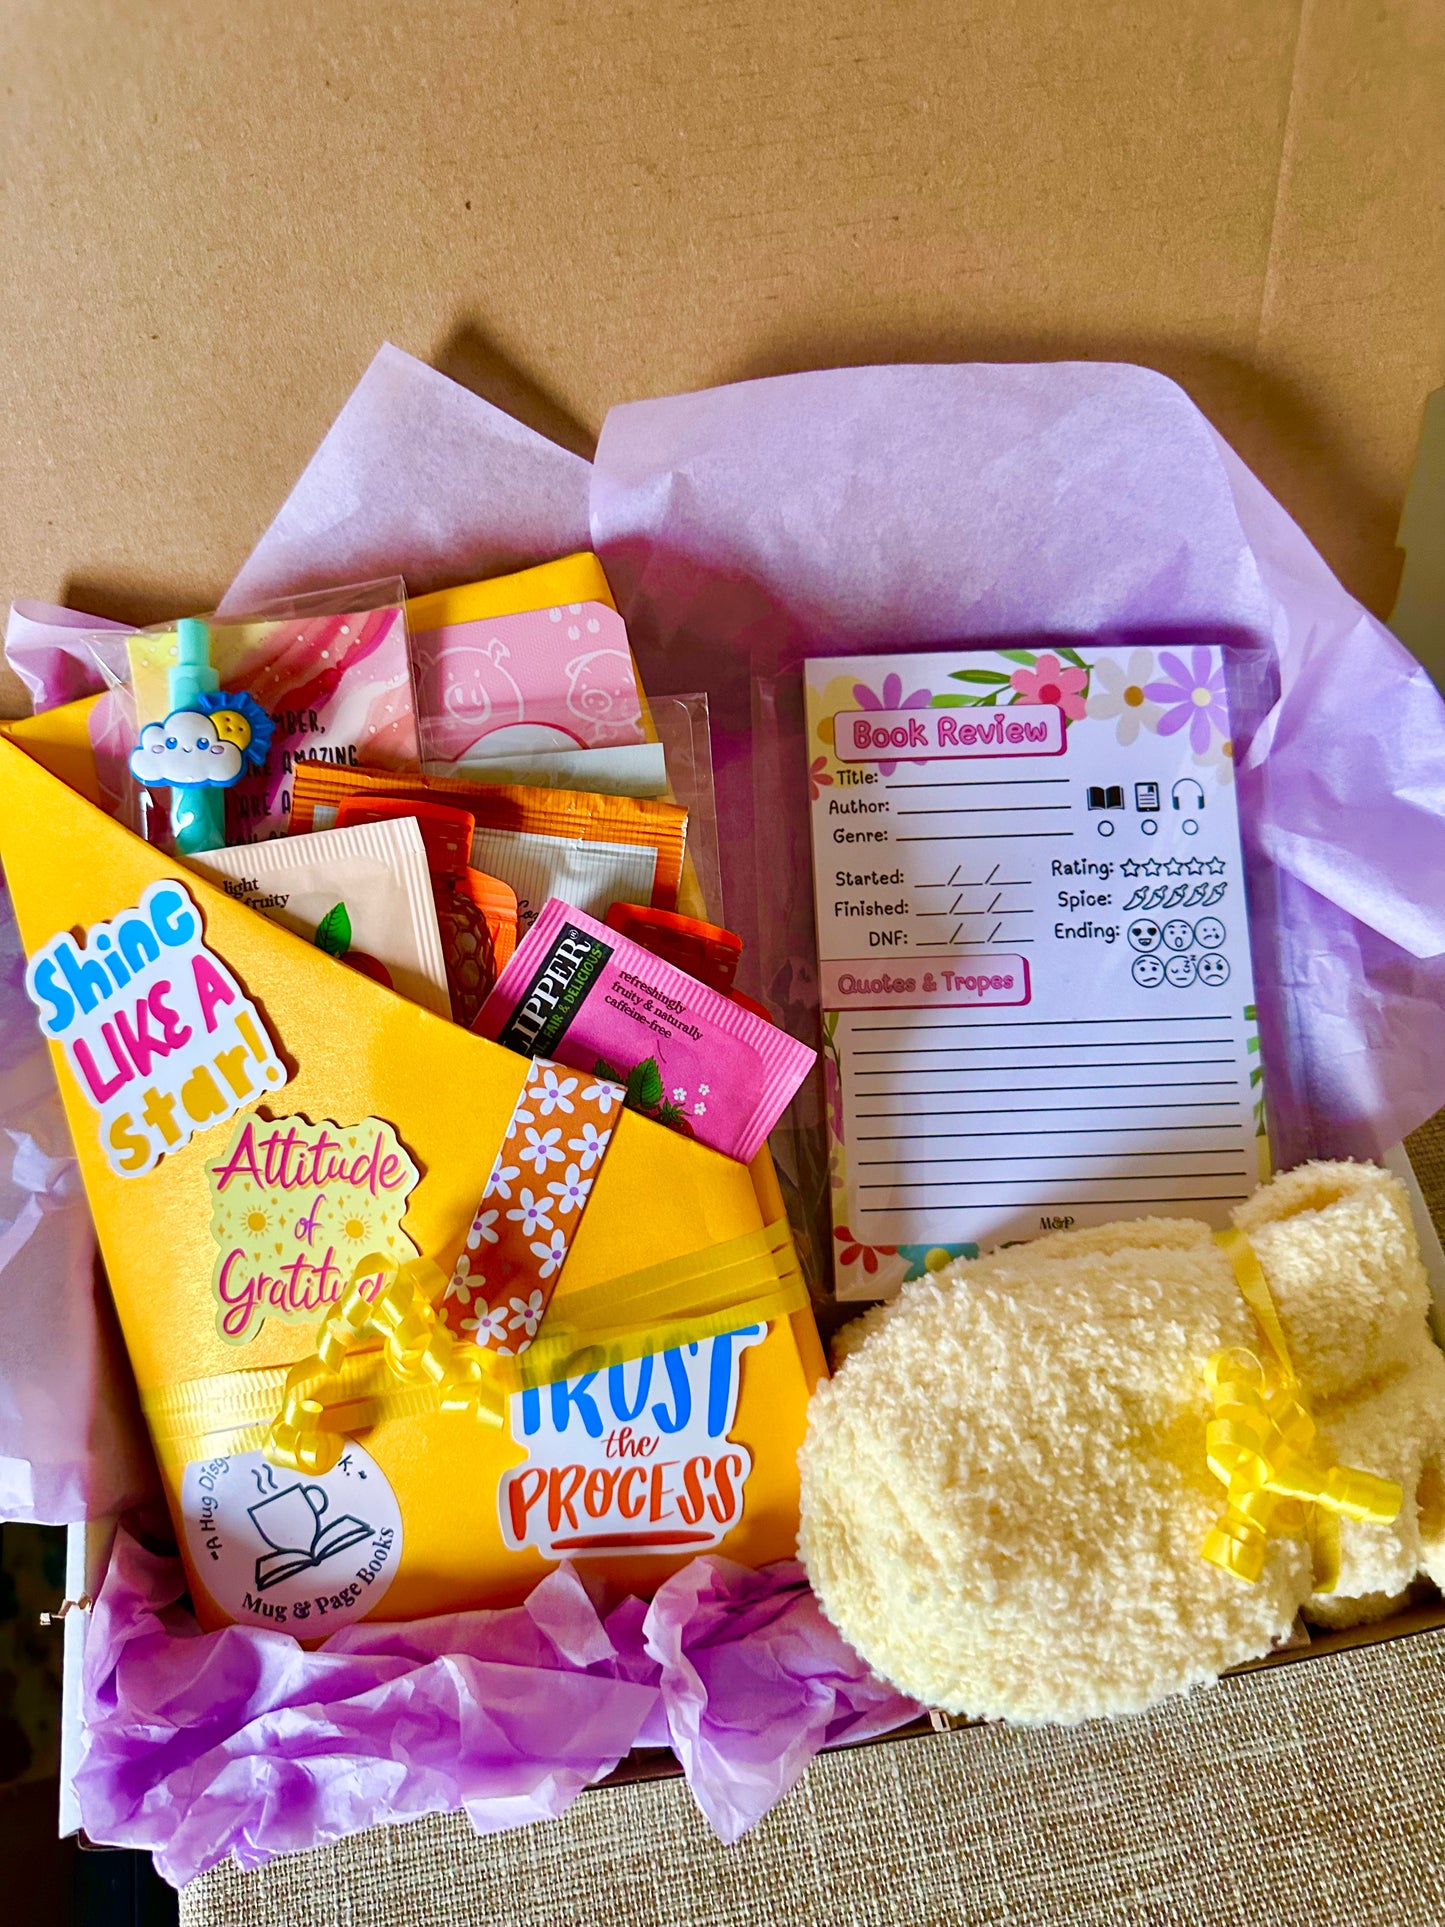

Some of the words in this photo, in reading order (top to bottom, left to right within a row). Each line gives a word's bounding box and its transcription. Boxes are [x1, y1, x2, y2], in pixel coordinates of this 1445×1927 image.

[852, 719, 928, 750] Book
[936, 713, 1048, 749] Review
[836, 770, 879, 785] Title:
[828, 800, 890, 816] Author:
[833, 829, 888, 845] Genre:
[835, 871, 905, 887] Started:
[1051, 858, 1114, 878] Rating:
[223, 877, 260, 899] light
[243, 894, 290, 910] fruity
[1057, 890, 1112, 911] Spice:
[834, 901, 909, 917] Finished:
[868, 931, 908, 946] DNF:
[1054, 923, 1120, 943] Ending:
[33, 890, 196, 1032] Shine
[619, 970, 686, 1014] refreshingly
[838, 972, 916, 995] Quotes
[922, 970, 938, 991] &
[941, 969, 1014, 996] Tropes
[544, 1016, 564, 1039] FAIR
[558, 1004, 571, 1014] &
[604, 994, 672, 1039] caffeine-free
[611, 981, 644, 1005] fruity
[643, 1000, 654, 1012] &
[653, 1007, 704, 1041] naturally
[73, 980, 192, 1104] LIKE
[192, 955, 236, 1033] A
[212, 1122, 408, 1195] Attitude
[294, 1193, 326, 1246] of
[1040, 1215, 1075, 1230] M&P
[601, 1427, 660, 1458] the
[199, 1455, 230, 1491] Disg
[508, 1454, 743, 1541] PROCESS
[200, 1496, 219, 1531] Hug
[242, 1592, 287, 1622] Mug
[293, 1601, 313, 1618] &
[314, 1582, 362, 1614] Page
[356, 1526, 394, 1585] Books
